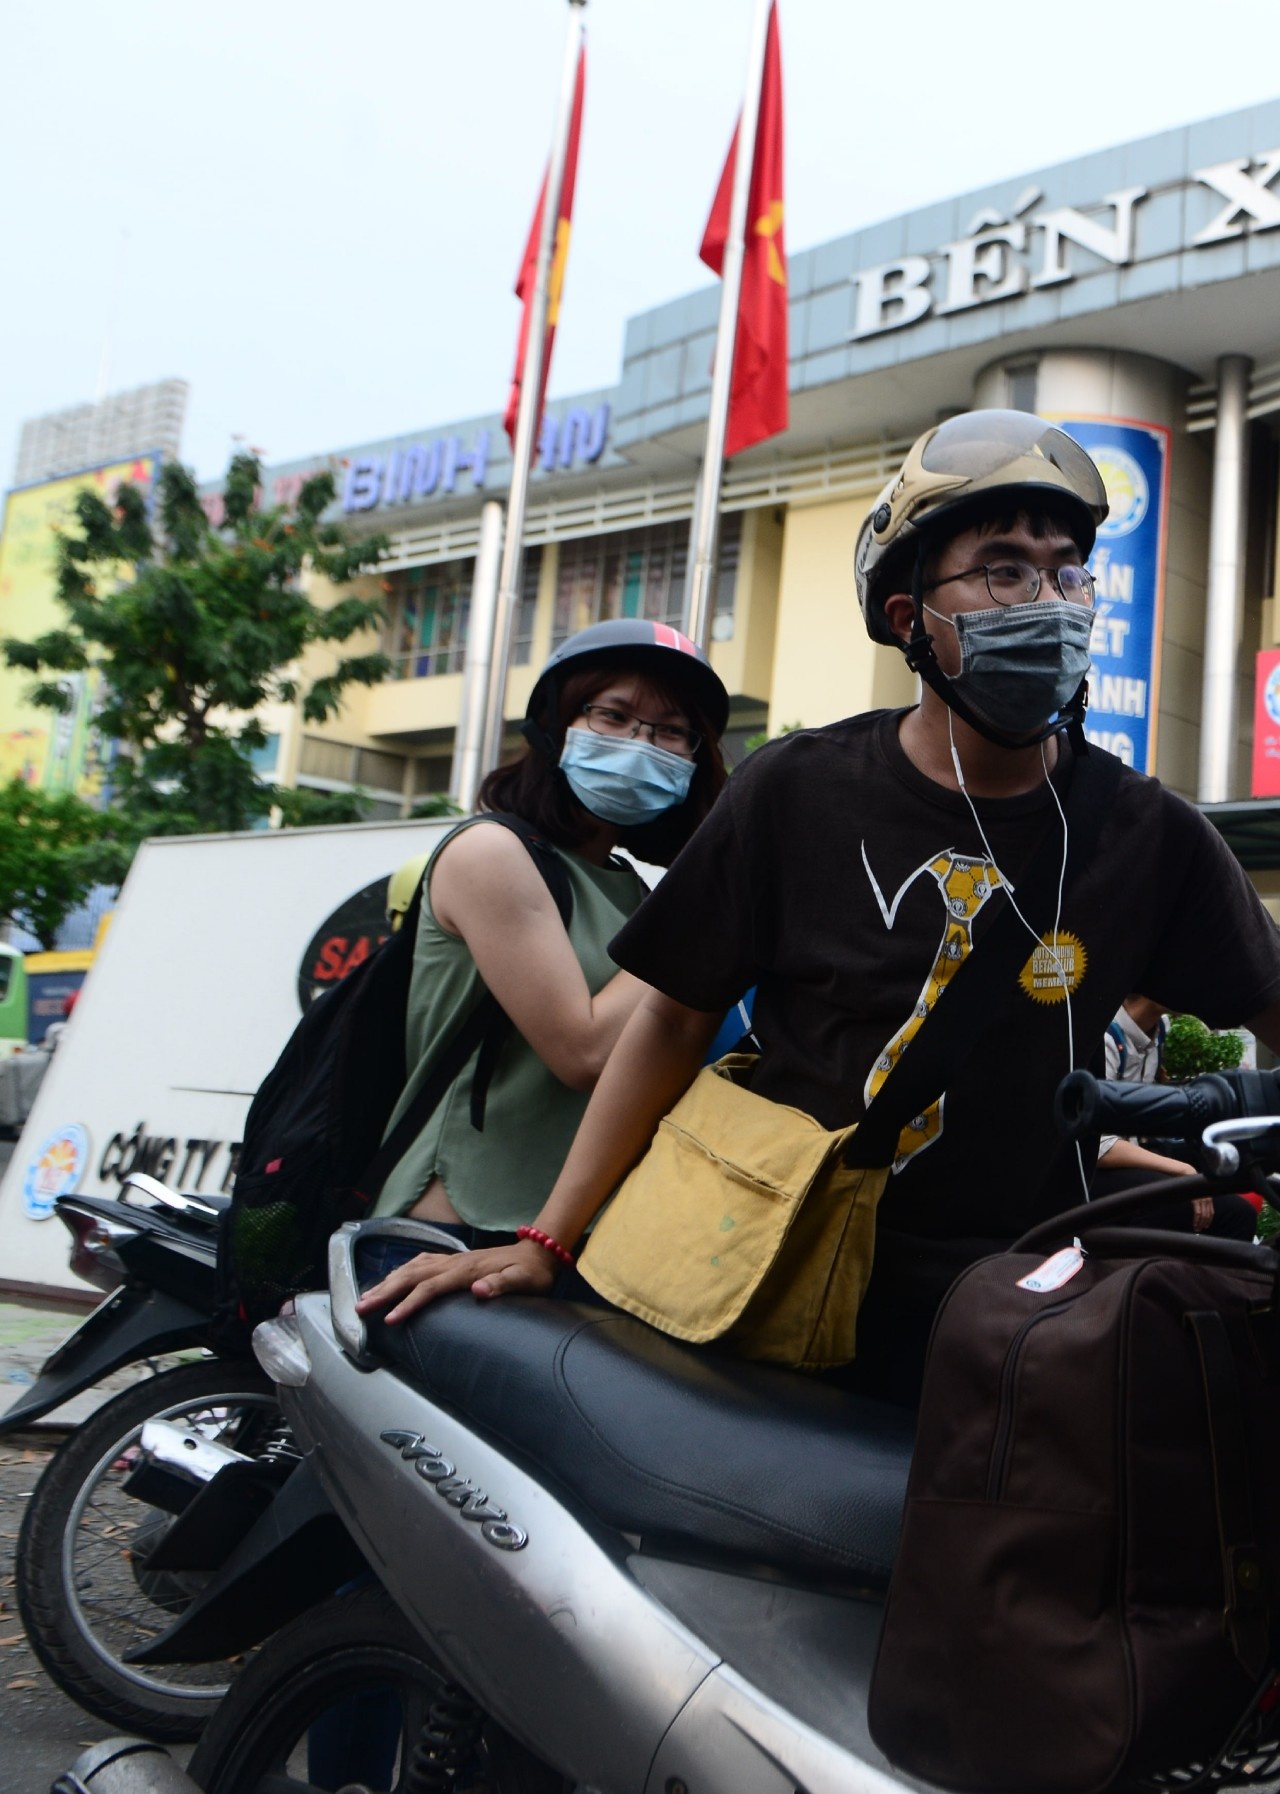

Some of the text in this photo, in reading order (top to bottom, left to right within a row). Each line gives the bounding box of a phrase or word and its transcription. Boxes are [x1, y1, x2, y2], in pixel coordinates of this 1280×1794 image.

[849, 184, 1149, 343] BẾN
[313, 935, 387, 980] SA
[1032, 945, 1075, 960] OUTSTNDING
[1032, 957, 1076, 974] BETA LUB
[177, 1138, 223, 1192] TY
